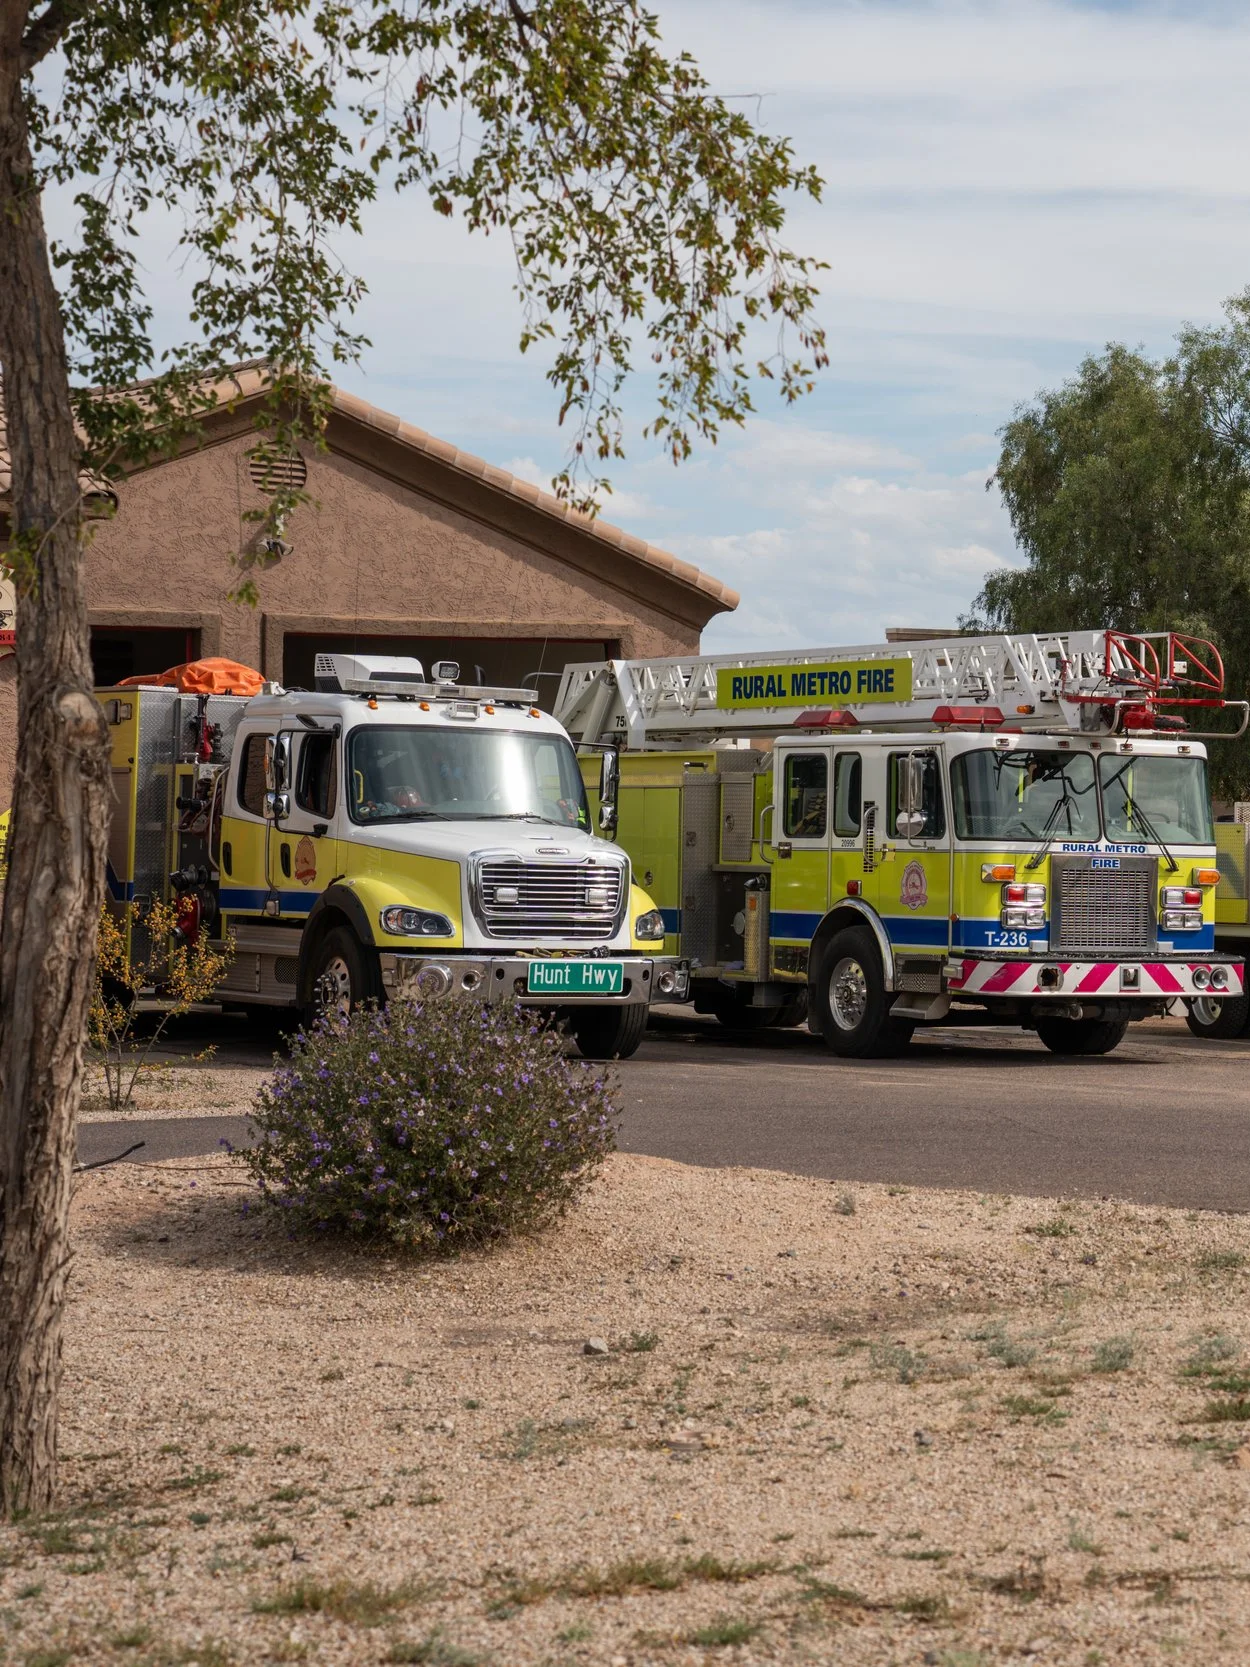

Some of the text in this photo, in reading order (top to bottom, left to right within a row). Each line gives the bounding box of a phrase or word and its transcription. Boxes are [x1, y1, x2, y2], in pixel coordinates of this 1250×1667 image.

[732, 668, 894, 699] RURAL METRO FIRE
[1063, 843, 1146, 853] RURAL METRO
[1092, 859, 1119, 868] FIRE
[984, 931, 1027, 946] T-236
[533, 964, 618, 990] Hunt Hwy
